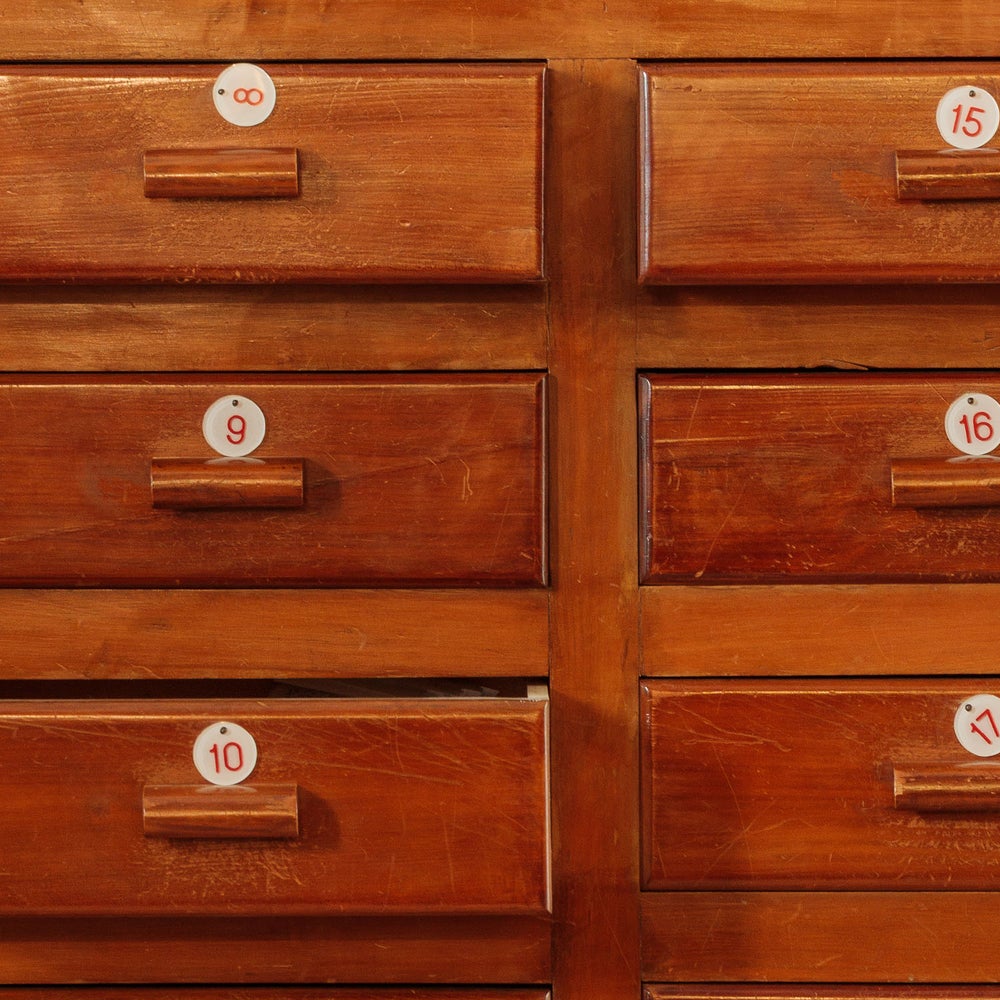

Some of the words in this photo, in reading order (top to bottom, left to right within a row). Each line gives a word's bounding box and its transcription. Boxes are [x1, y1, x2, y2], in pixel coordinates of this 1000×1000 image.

[233, 87, 264, 106] 8
[952, 104, 985, 137] 15
[226, 414, 247, 445] 9
[960, 411, 994, 444] 16
[970, 709, 1000, 745] 17
[209, 741, 245, 774] 10
